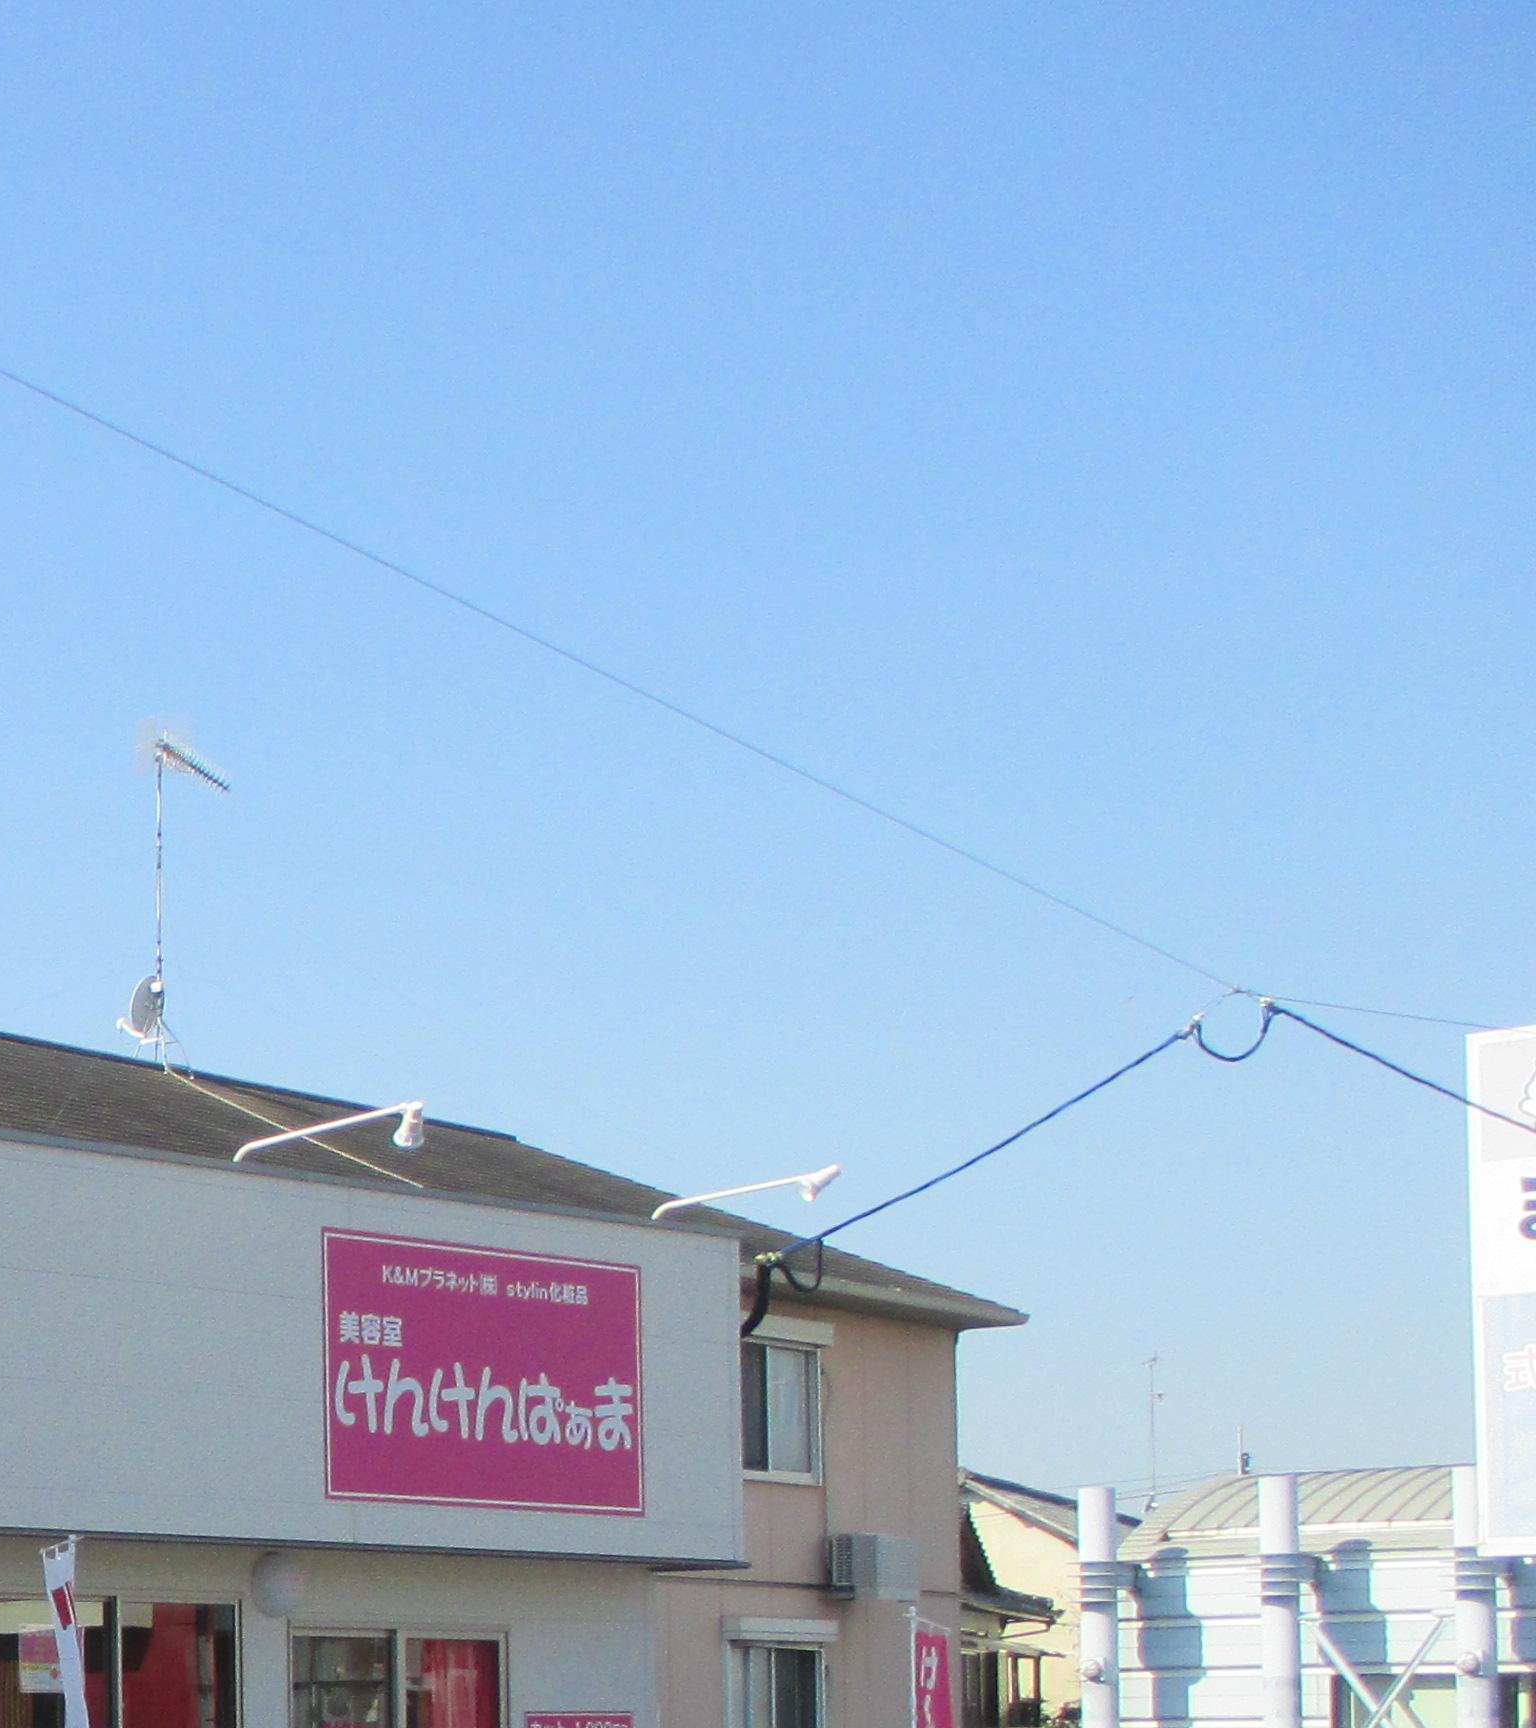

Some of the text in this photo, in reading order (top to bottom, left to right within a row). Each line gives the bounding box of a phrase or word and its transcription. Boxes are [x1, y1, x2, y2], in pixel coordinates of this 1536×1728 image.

[339, 1311, 403, 1348] 美容室
[334, 1354, 634, 1450] けんけんぱぁま
